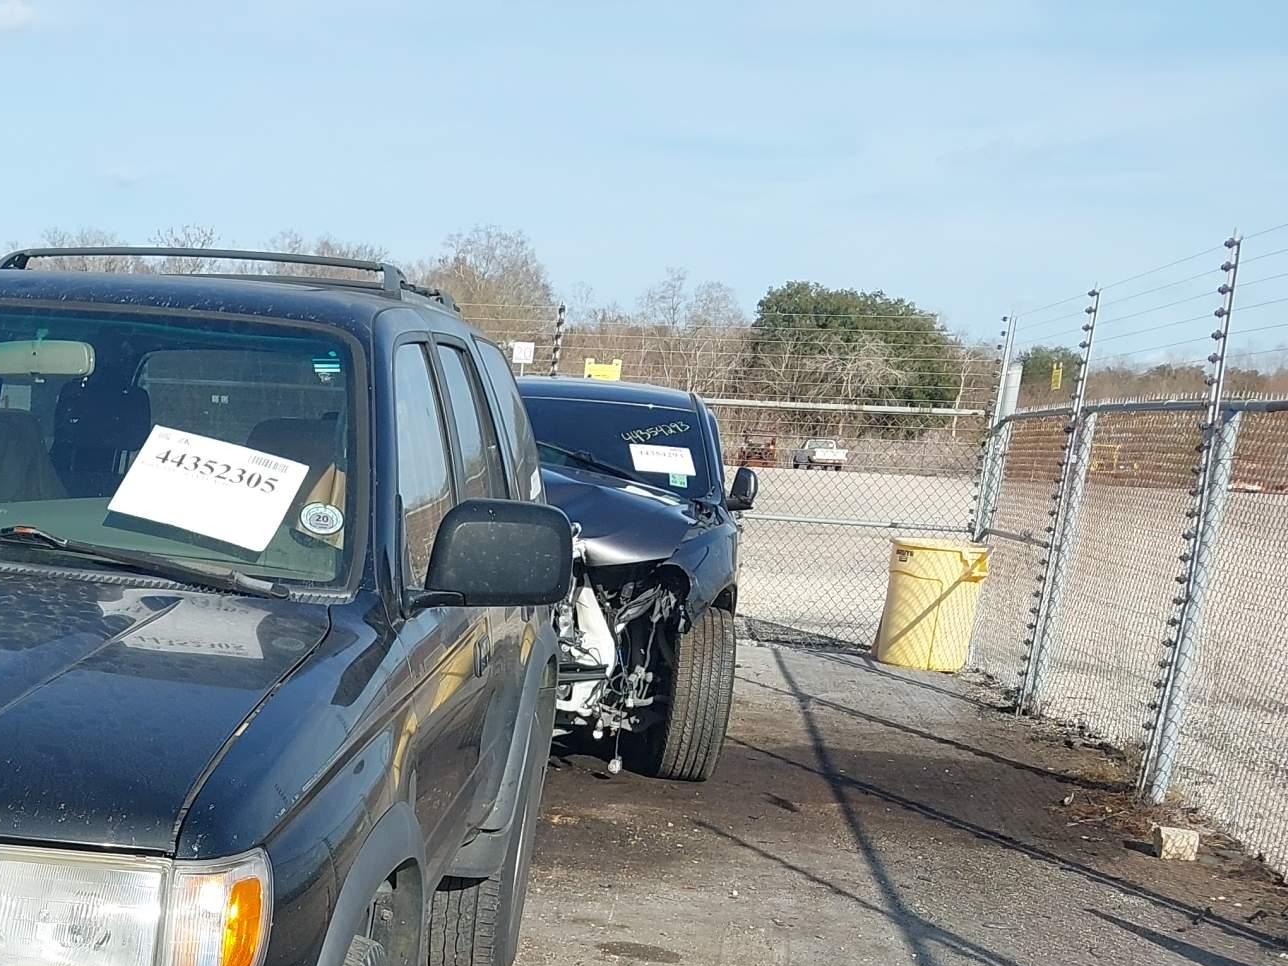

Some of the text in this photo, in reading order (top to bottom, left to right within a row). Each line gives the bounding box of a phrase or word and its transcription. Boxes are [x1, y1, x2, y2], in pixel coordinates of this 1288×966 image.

[620, 421, 691, 444] 44354293
[155, 449, 280, 494] 44352305
[315, 514, 329, 523] 20
